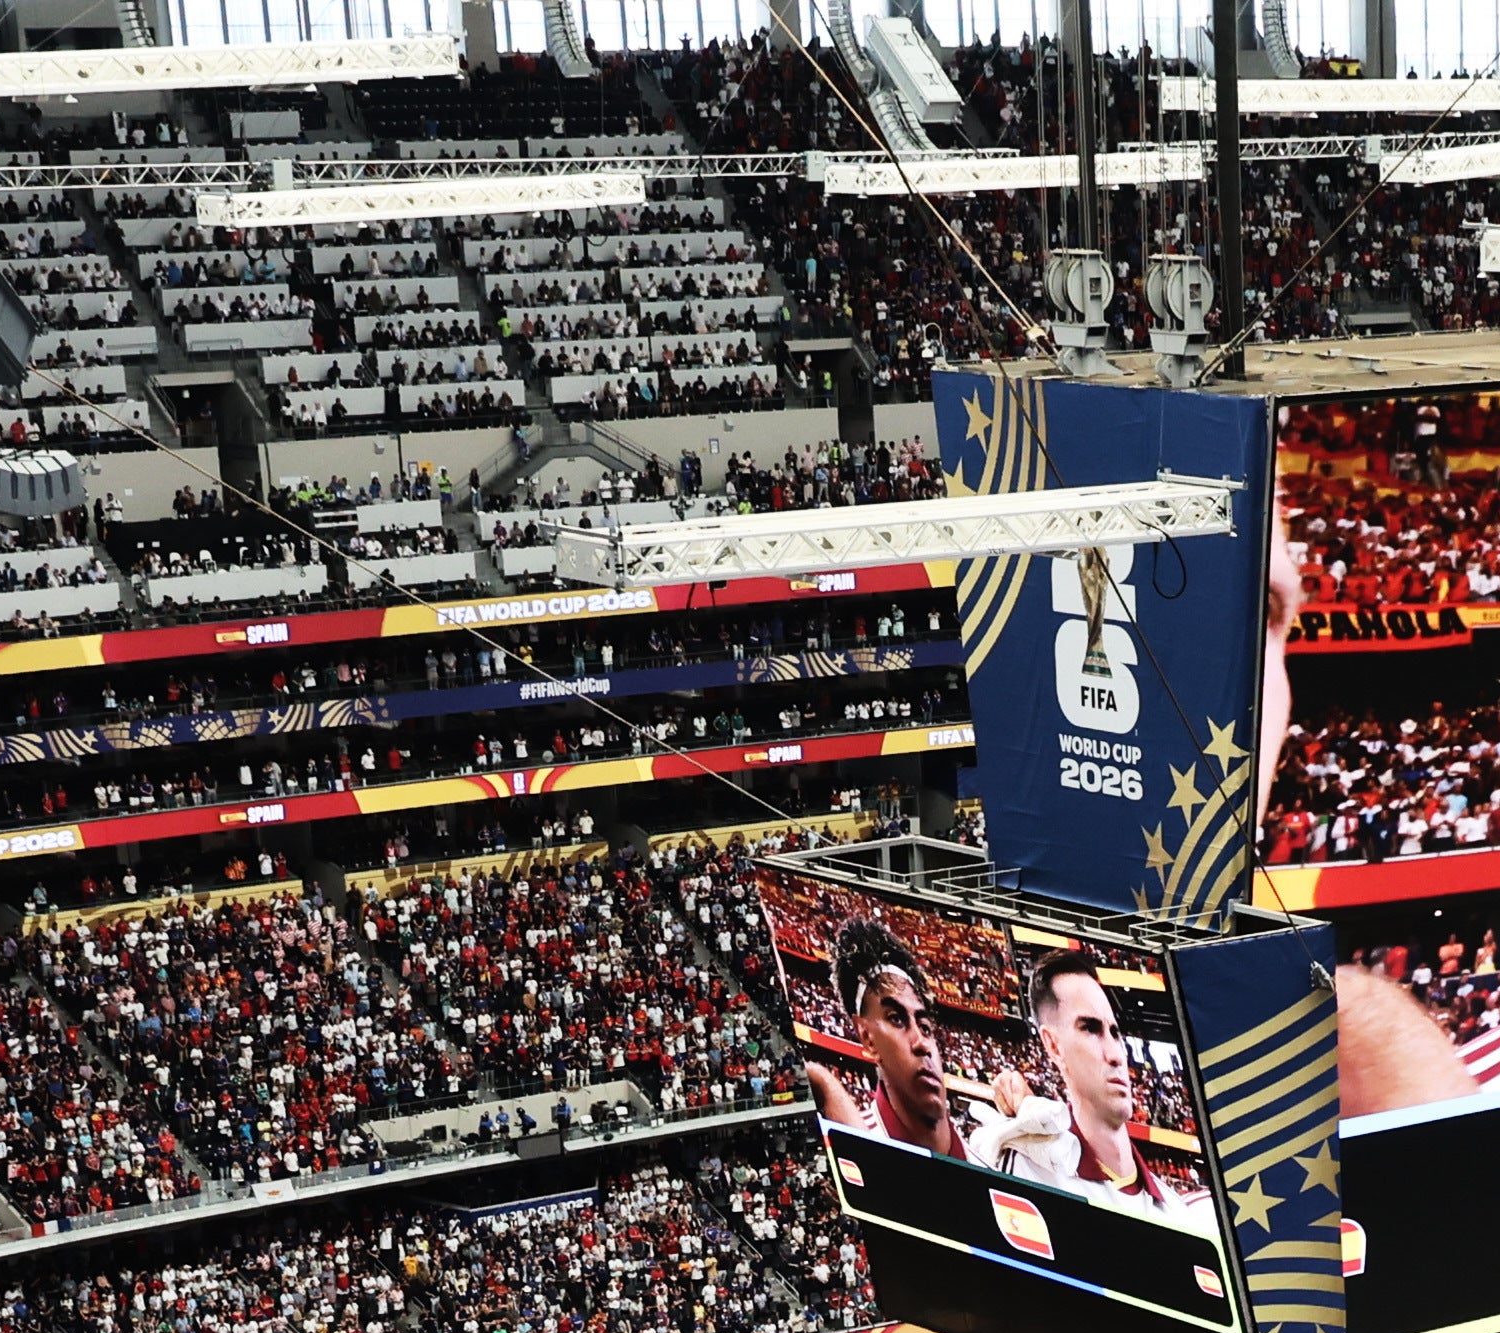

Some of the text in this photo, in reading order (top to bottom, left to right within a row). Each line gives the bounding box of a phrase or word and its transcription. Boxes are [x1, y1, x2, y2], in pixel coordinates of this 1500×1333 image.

[437, 590, 653, 626] FIFA WORLD CUP 2026
[246, 623, 289, 645] SPAIN
[519, 679, 611, 701] #FIFAWorldCup
[1080, 685, 1117, 712] FIFA
[767, 745, 802, 763] SPAIN
[1059, 733, 1141, 765] WORLD CUP
[1060, 758, 1143, 800] 2026
[246, 804, 285, 824] SPAIN
[9, 829, 76, 853] 2026
